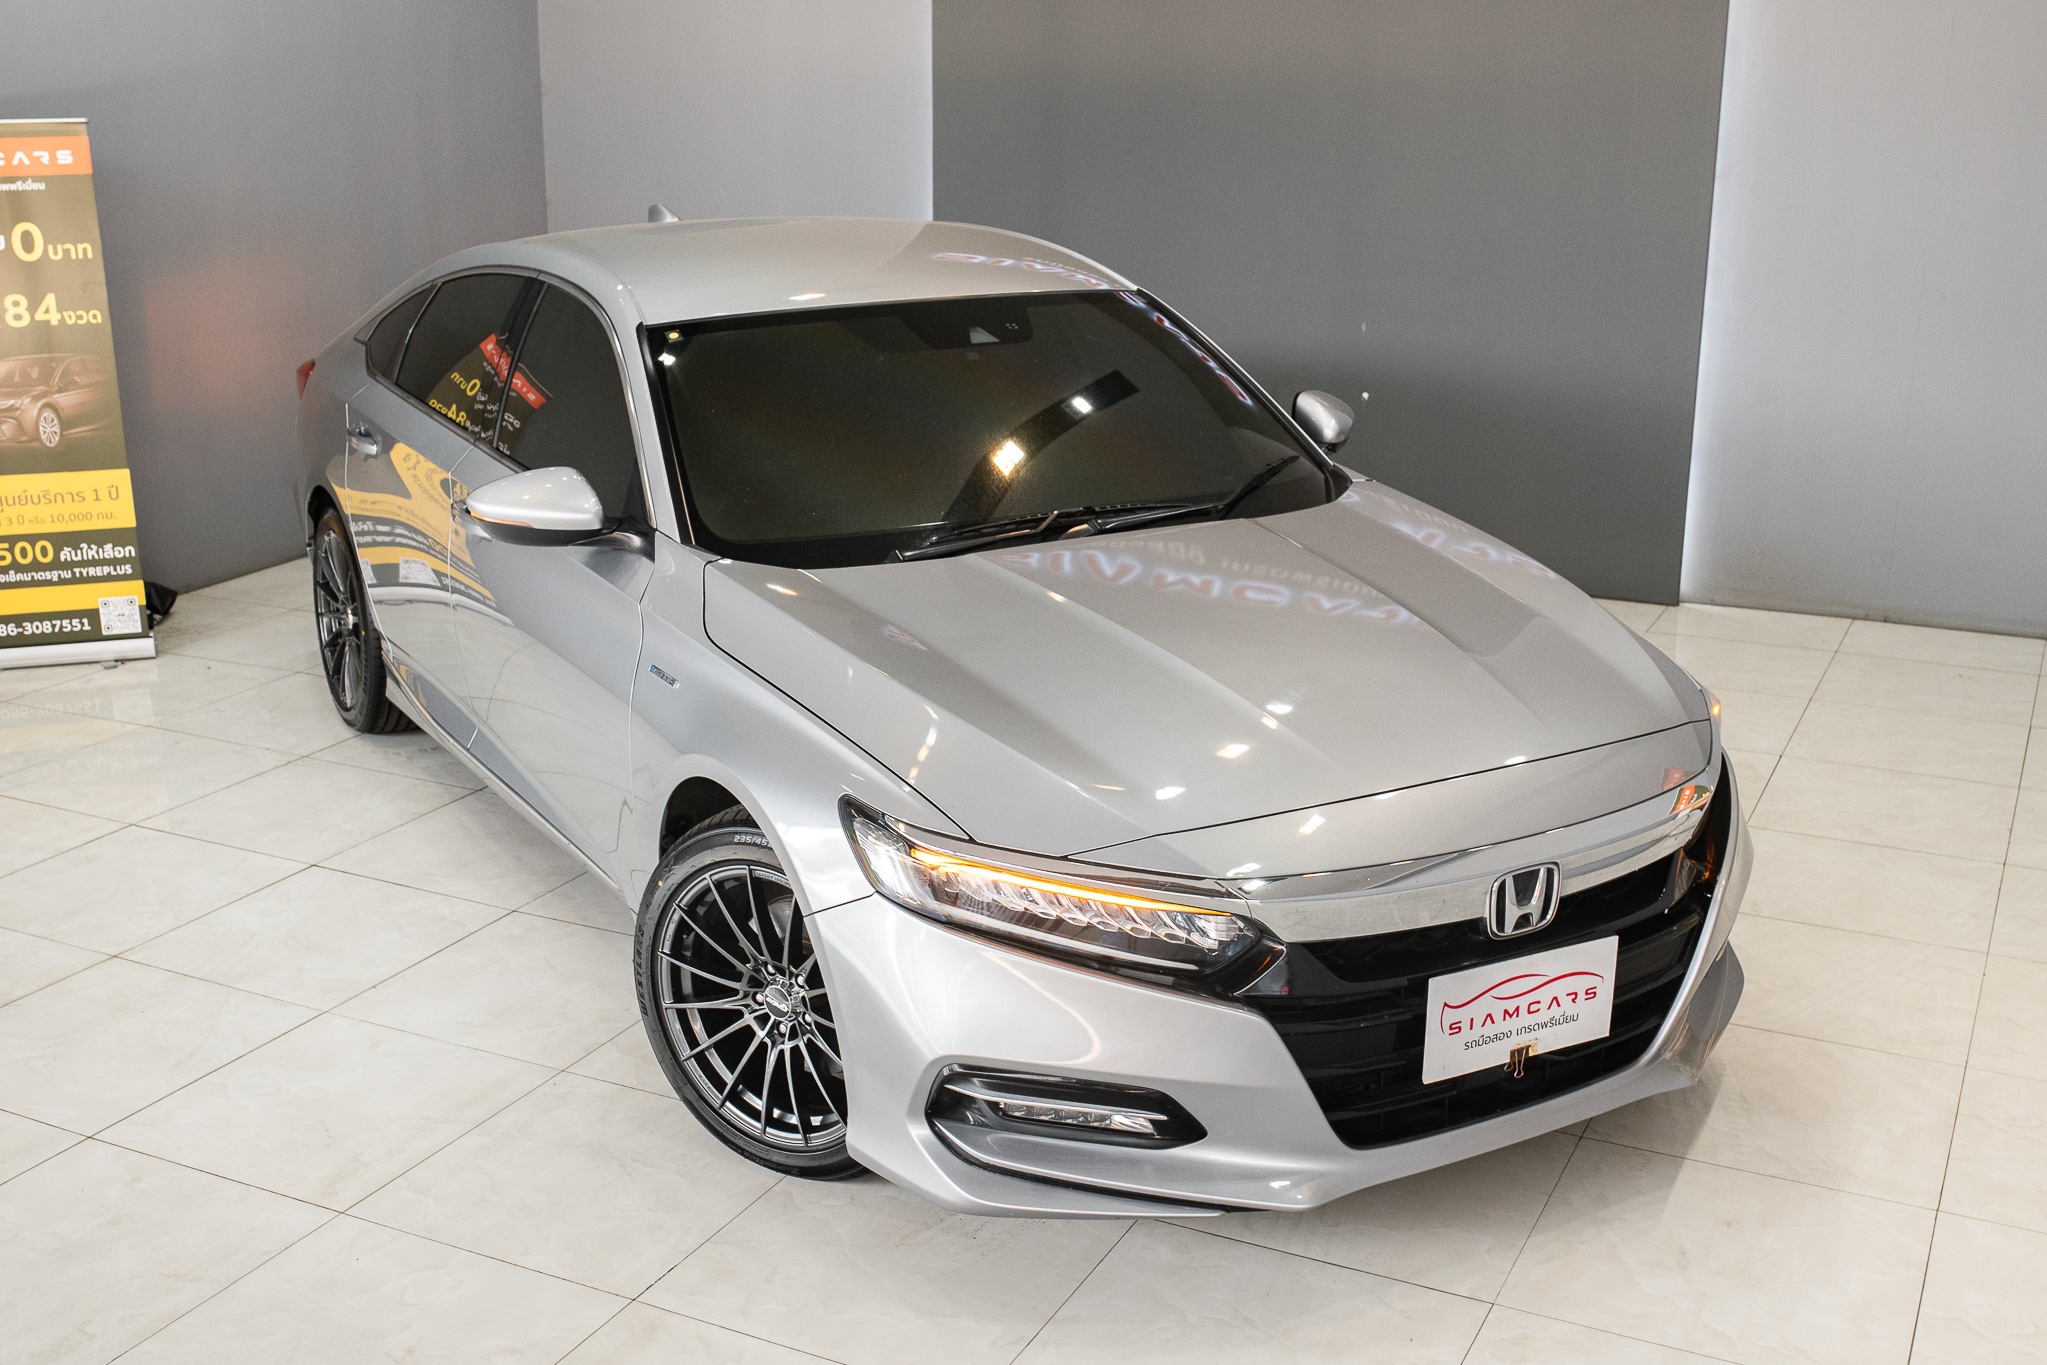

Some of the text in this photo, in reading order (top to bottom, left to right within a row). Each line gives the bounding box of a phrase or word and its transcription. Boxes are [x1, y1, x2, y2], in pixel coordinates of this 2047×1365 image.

[11, 222, 44, 262] 0
[47, 243, 93, 260] บาท
[3, 293, 102, 328] 84 งวด
[92, 488, 102, 502] 1
[49, 511, 93, 525] 10,000
[60, 542, 136, 562] คันให้เลือก
[73, 564, 133, 578] TYREPLUS
[1448, 986, 1598, 1036] SIAMCARS
[1464, 1011, 1579, 1050] รถมือสอง เกรดพรีเมี่ยม
